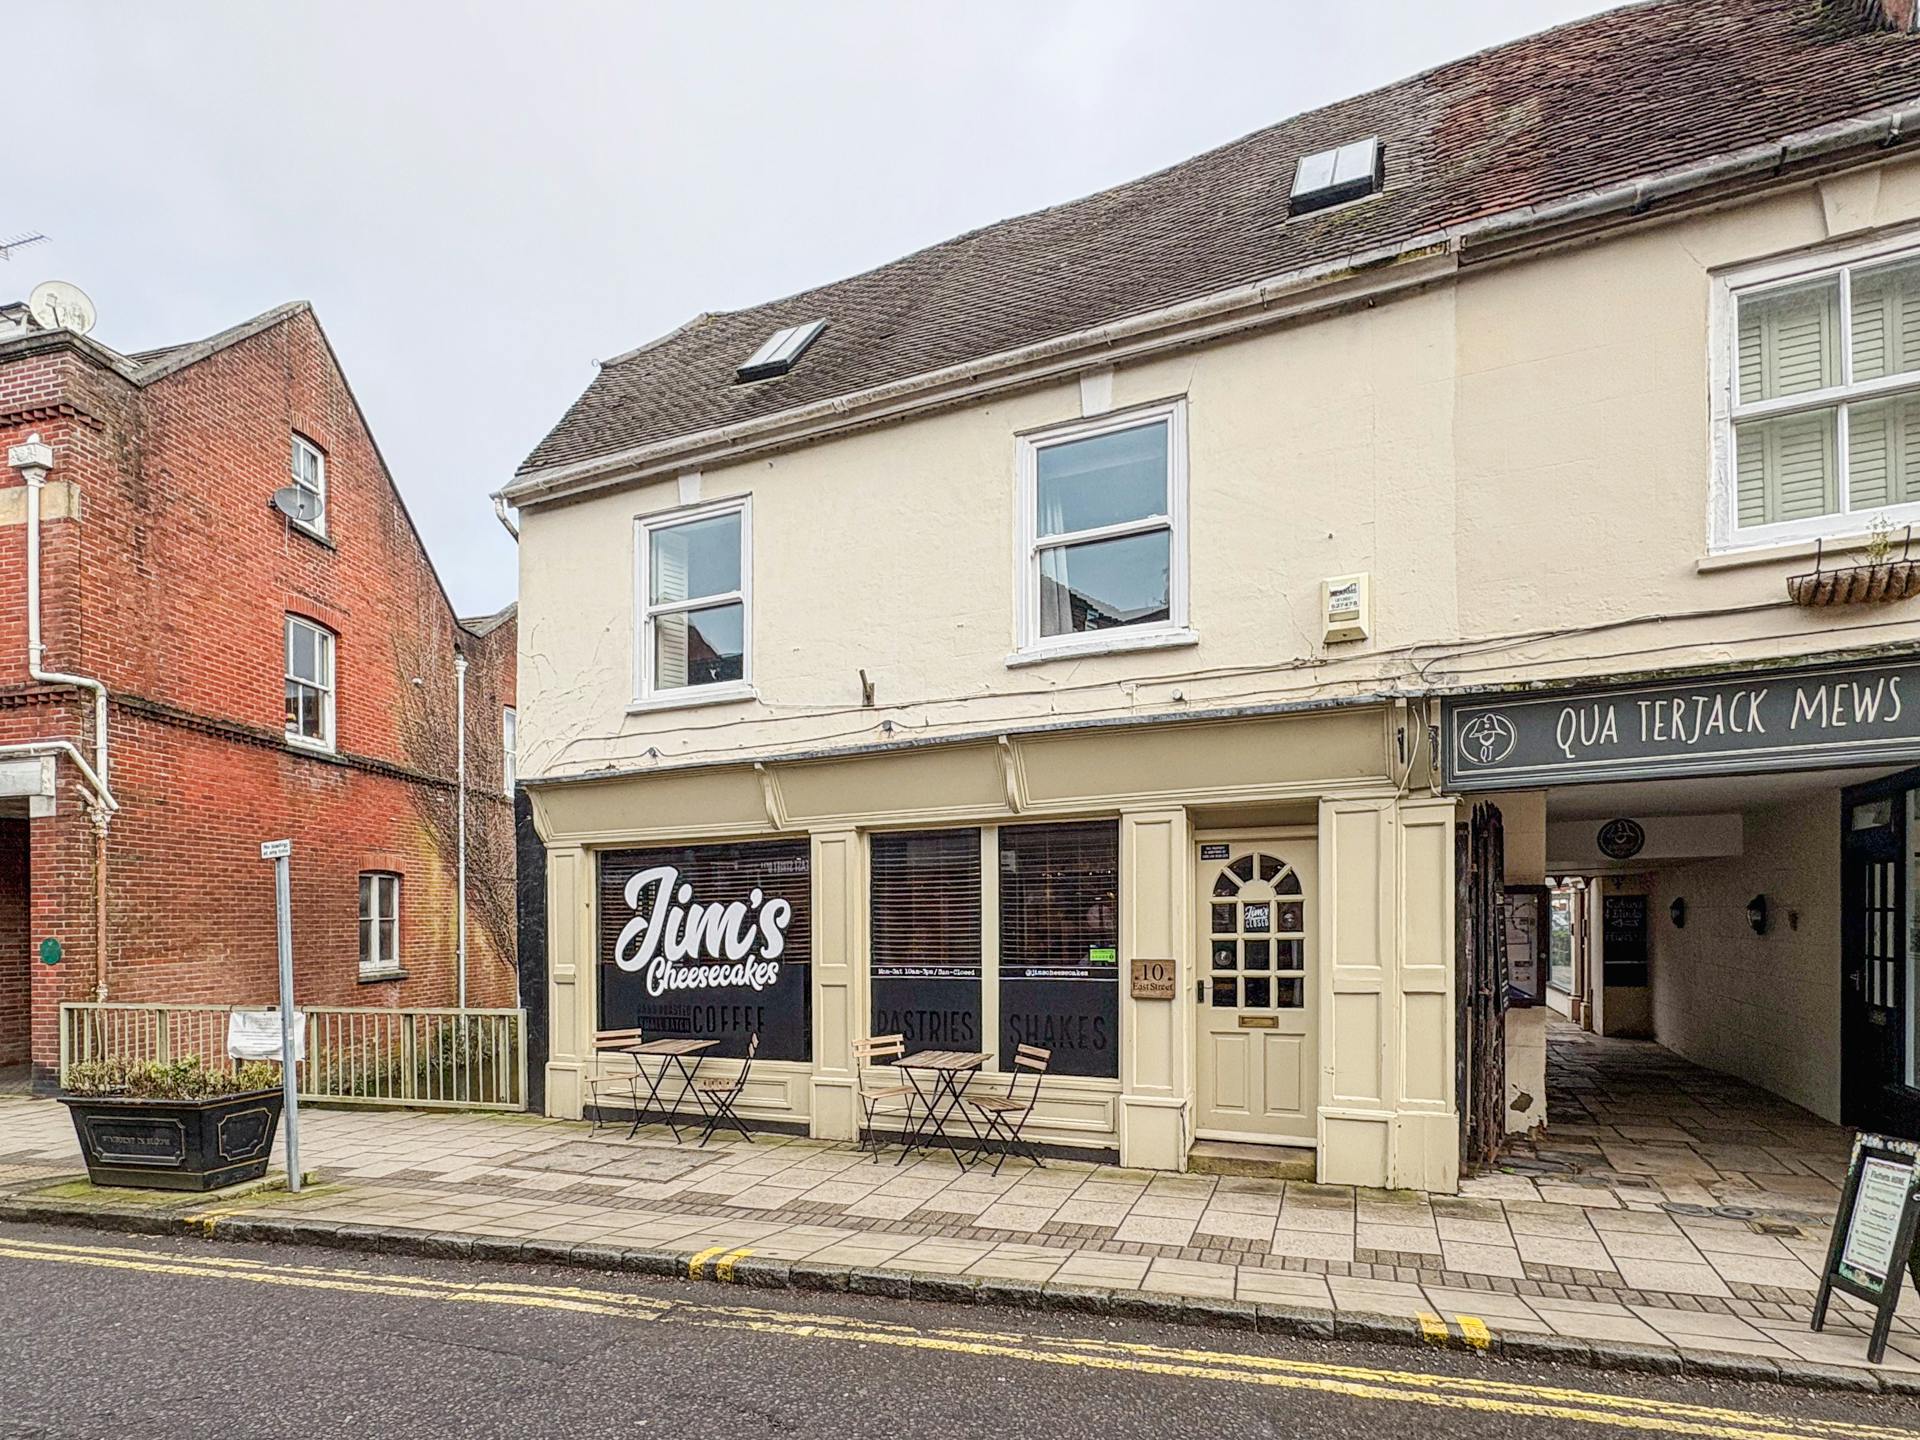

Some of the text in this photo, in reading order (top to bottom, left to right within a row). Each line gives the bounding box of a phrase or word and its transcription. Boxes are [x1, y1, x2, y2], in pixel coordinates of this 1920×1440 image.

[1790, 676, 1901, 731] MEWS
[615, 866, 791, 972] Jim's
[646, 955, 779, 997] Cheesecakes
[1133, 982, 1174, 991] East Street
[1143, 963, 1164, 981] 10
[693, 1005, 765, 1033] COFFEE
[877, 1009, 974, 1044] PASTRIES
[1009, 1013, 1108, 1050] SHAKES
